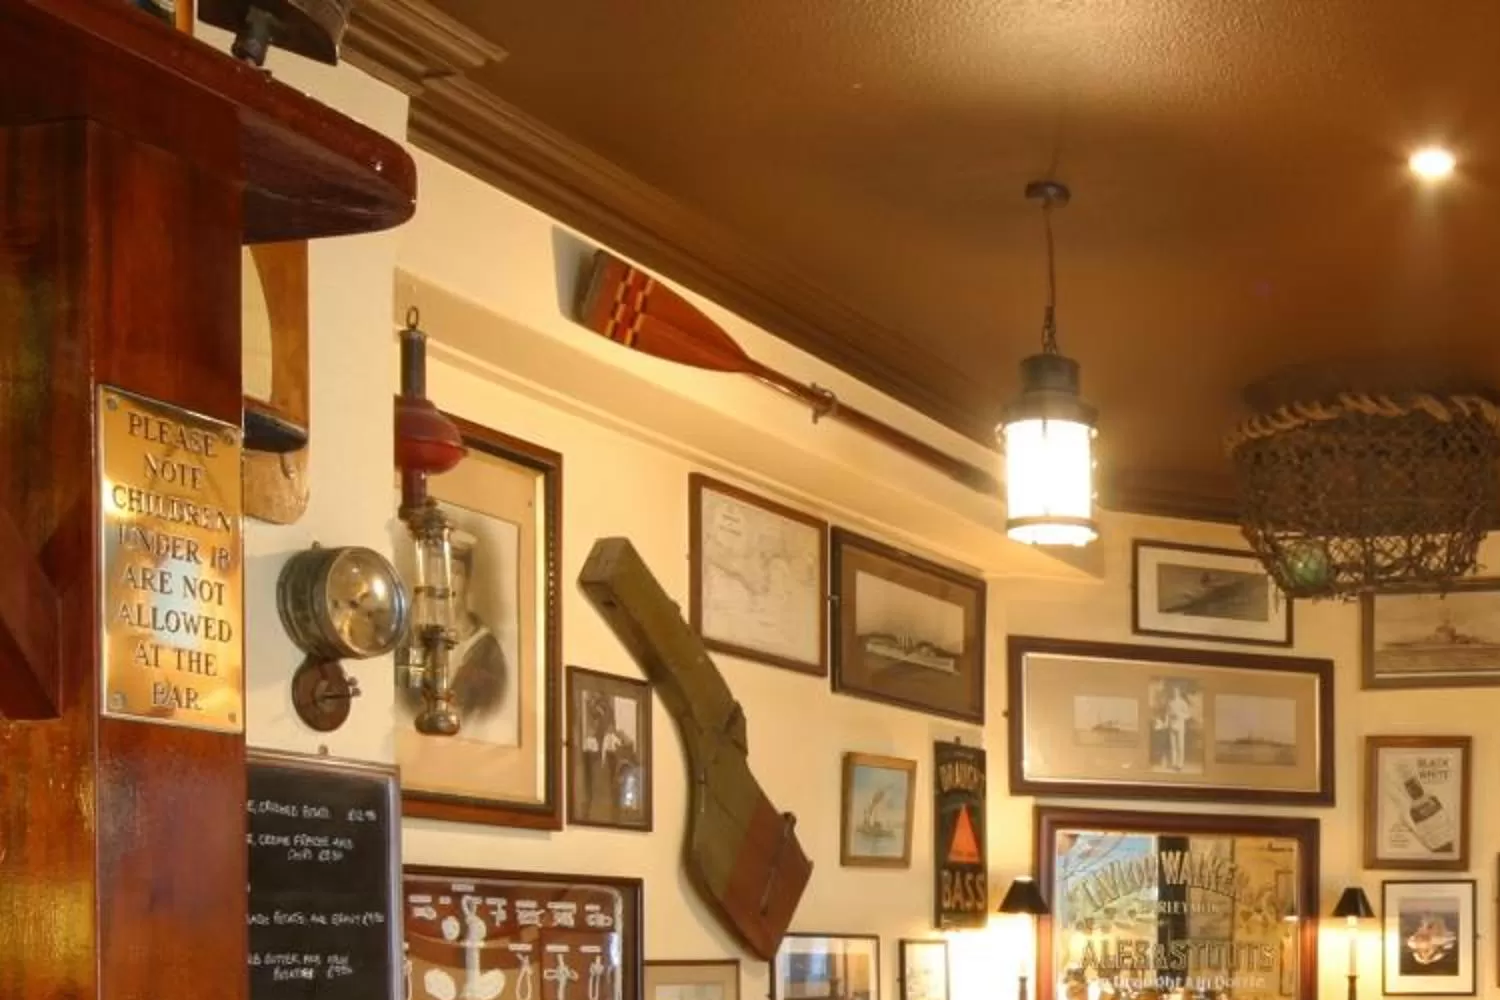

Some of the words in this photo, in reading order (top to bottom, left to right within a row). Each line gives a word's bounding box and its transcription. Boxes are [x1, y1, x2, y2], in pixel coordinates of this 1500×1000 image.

[127, 411, 219, 458] PLEASE
[143, 451, 204, 490] NOTE
[112, 484, 232, 534] CHILDREN
[118, 523, 203, 565] UNDER
[123, 566, 173, 595] ARE
[182, 574, 226, 606] NOT
[118, 602, 233, 643] ALLOWED
[134, 641, 162, 669] AT
[173, 647, 218, 677] THE
[939, 870, 985, 910] BASS
[1082, 939, 1153, 970] ALES
[1168, 940, 1277, 973] STOUTS
